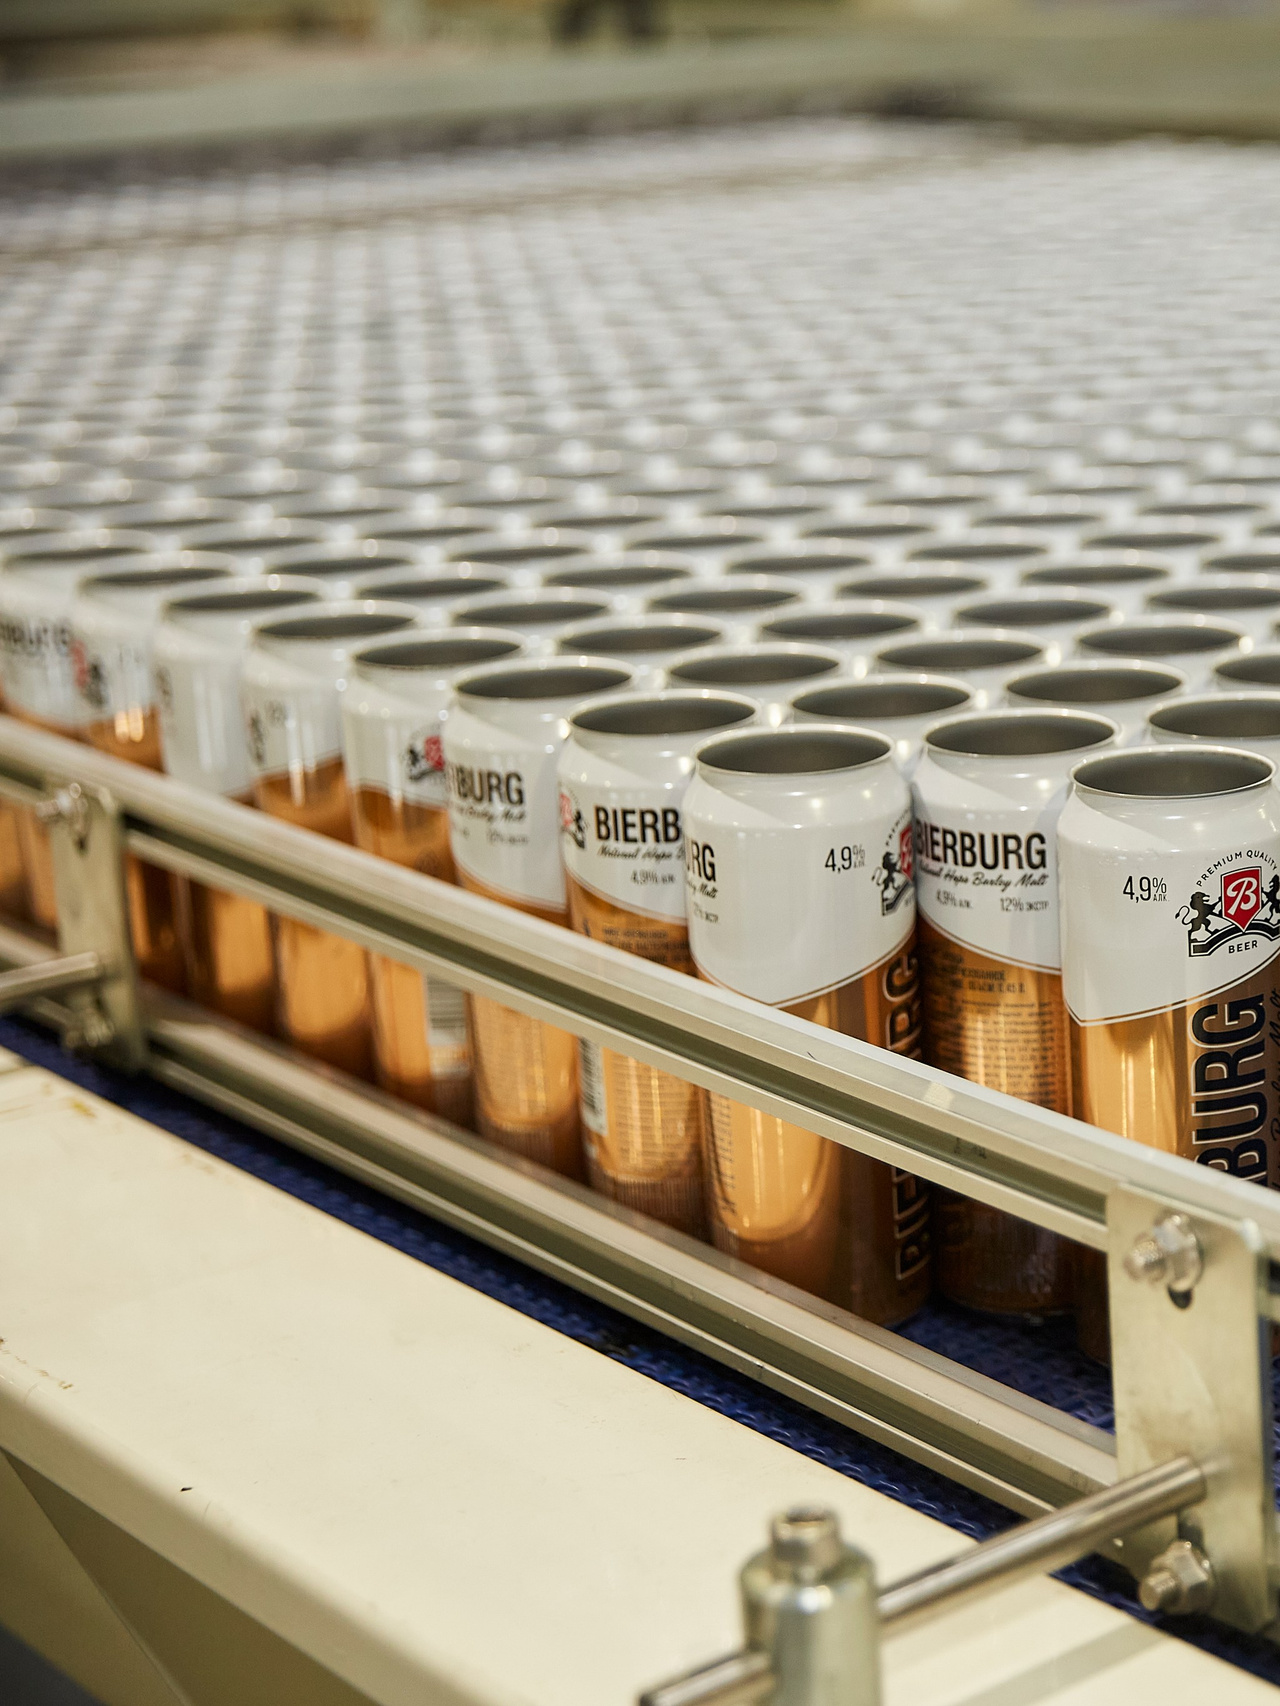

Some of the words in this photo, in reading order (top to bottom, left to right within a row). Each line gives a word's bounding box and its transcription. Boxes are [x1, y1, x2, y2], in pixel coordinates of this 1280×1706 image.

[825, 846, 865, 873] 4,9%
[1196, 850, 1243, 887] PREMIUM
[1246, 849, 1277, 871] QUALITY
[1122, 875, 1167, 903] 4,9%
[1226, 876, 1258, 917] B
[1228, 939, 1258, 954] BEER
[1187, 993, 1268, 1188] BURG
